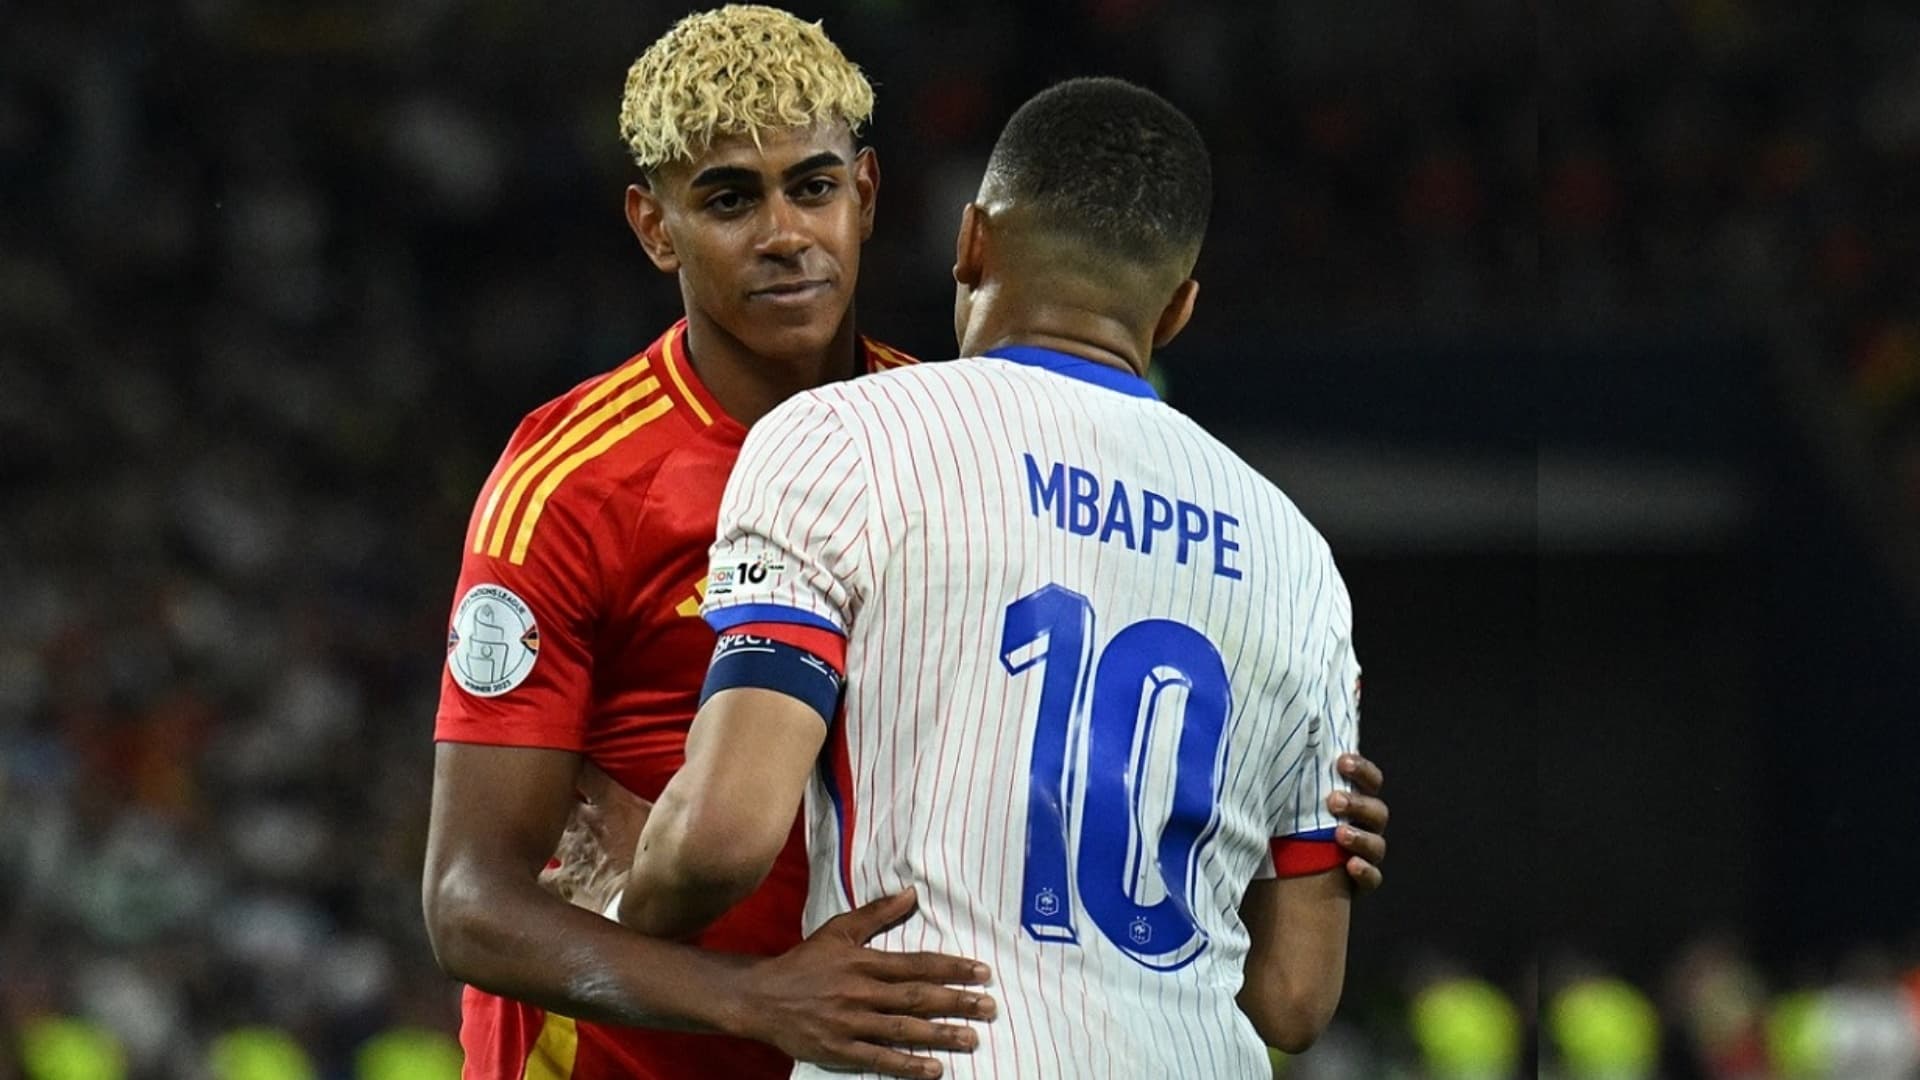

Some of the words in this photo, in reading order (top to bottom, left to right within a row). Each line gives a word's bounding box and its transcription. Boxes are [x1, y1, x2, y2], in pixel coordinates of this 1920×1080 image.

[737, 562, 768, 585] 10
[1023, 453, 1243, 580] MBAPPE
[1000, 582, 1234, 971] 10
